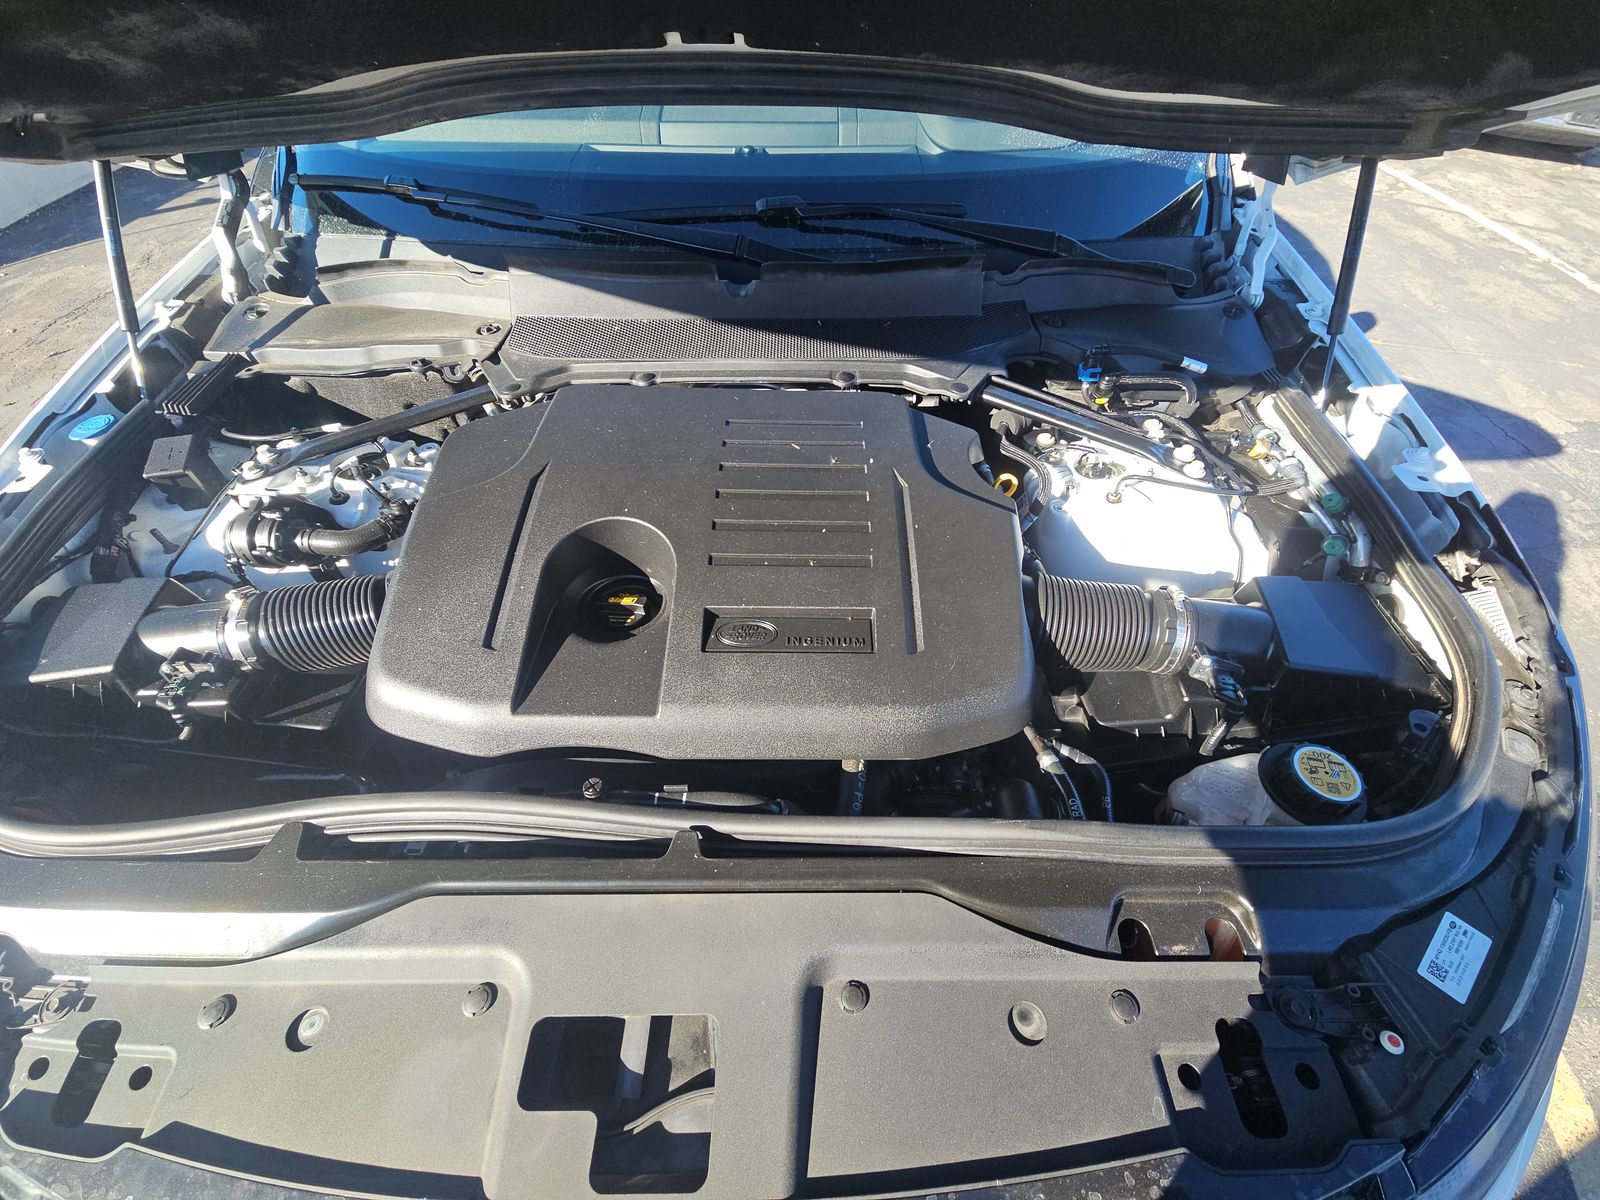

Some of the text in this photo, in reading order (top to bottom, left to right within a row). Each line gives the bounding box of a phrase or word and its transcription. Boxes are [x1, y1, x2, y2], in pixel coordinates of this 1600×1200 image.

[732, 624, 761, 632] LAND
[731, 632, 768, 640] ROVER
[785, 636, 866, 647] INGENIUM
[1069, 798, 1081, 817] RAD
